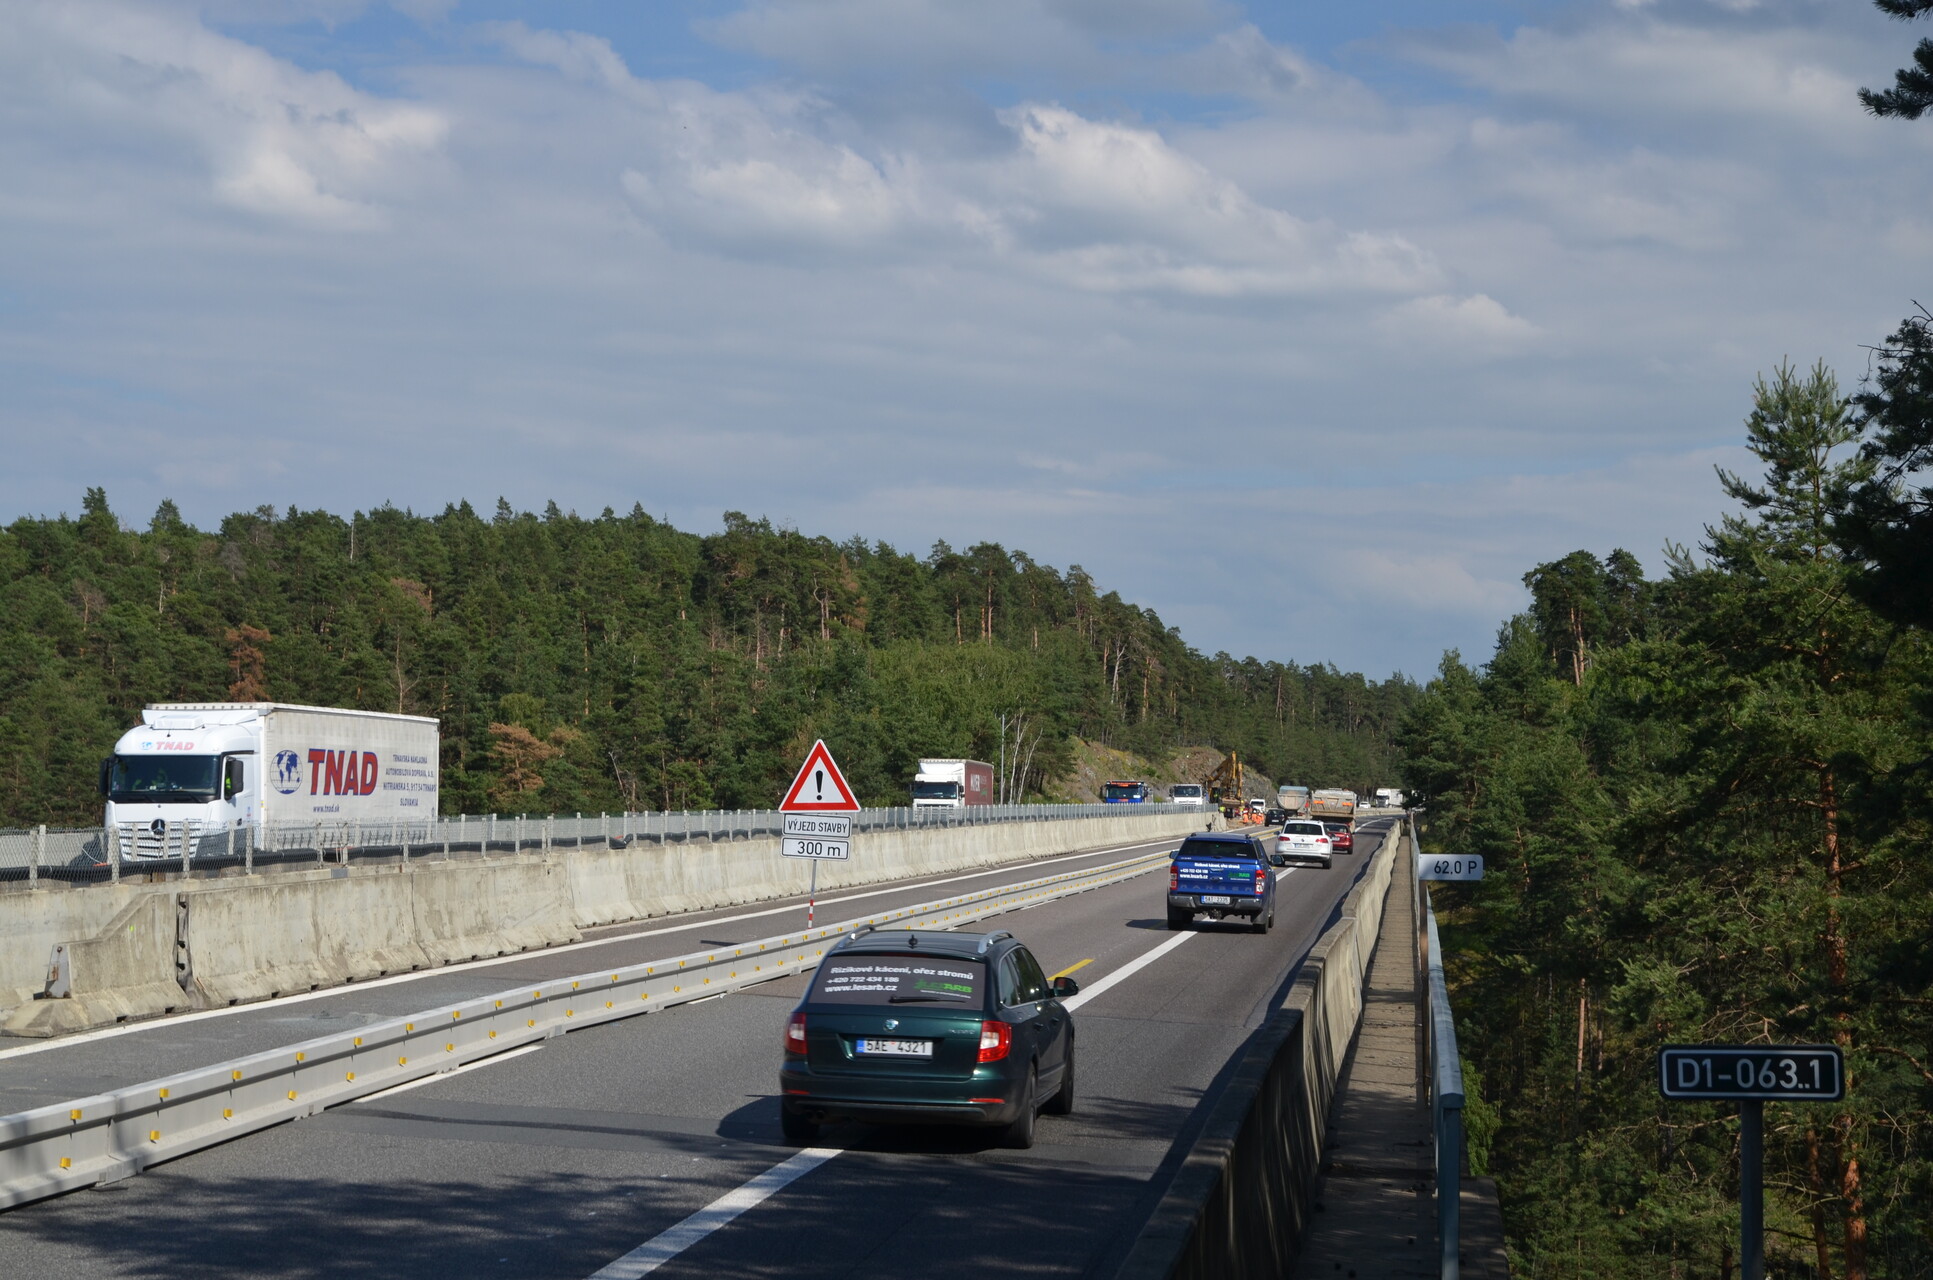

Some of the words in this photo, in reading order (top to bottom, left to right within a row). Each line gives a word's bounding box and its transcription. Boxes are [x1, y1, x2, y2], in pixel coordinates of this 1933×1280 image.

[156, 741, 194, 751] TNAD
[307, 748, 379, 796] TNAD
[313, 804, 340, 812] www.tnad.sk
[787, 818, 816, 832] VÝJEZD
[818, 821, 848, 834] STAVBY
[797, 840, 823, 856] 300
[827, 846, 841, 857] m
[1468, 860, 1478, 875] P
[830, 966, 874, 974] Rizikové
[874, 966, 912, 974] kácení,
[913, 967, 936, 975] ořez
[937, 970, 974, 980] stromů
[825, 984, 898, 992] www.lesarb.cz
[866, 1039, 887, 1052] 5AE
[897, 1041, 926, 1054] 4321
